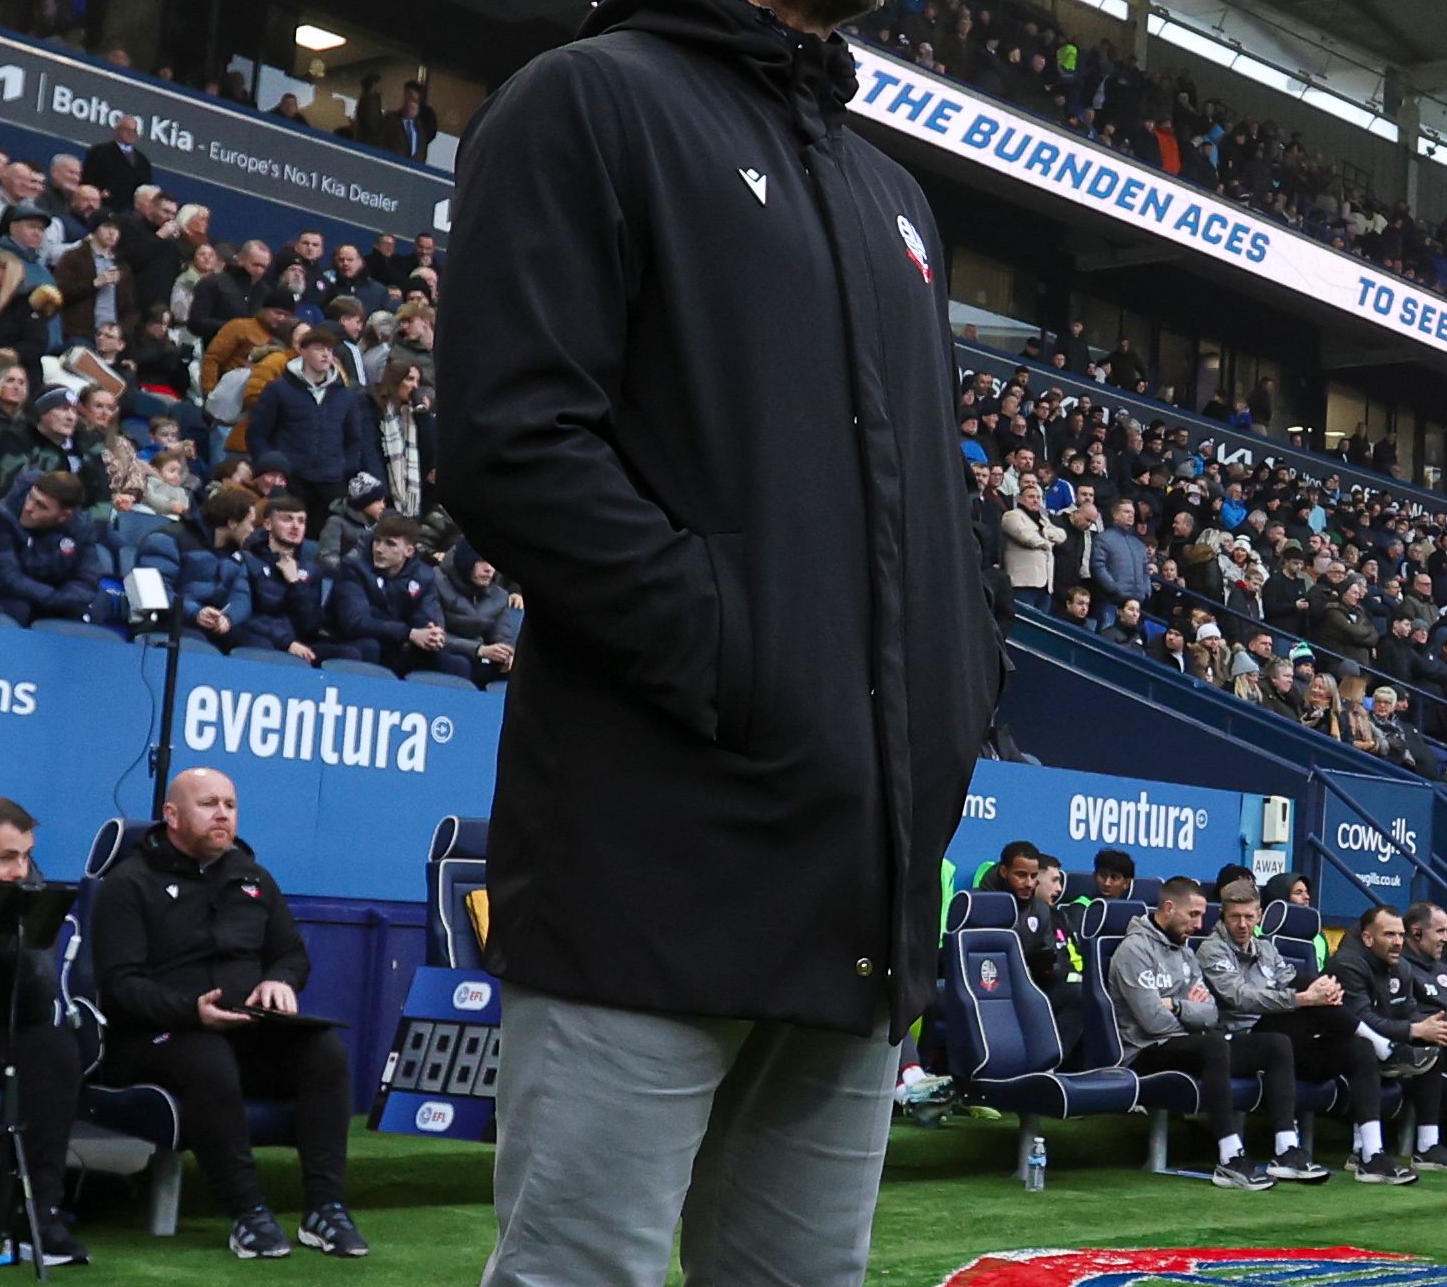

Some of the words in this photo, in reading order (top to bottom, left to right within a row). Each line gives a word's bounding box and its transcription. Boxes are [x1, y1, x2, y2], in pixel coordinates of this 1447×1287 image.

[150, 115, 194, 152] Kia
[209, 140, 280, 178] Europe's
[283, 163, 318, 190] No.1
[320, 174, 346, 198] Kia
[348, 183, 398, 214] Dealer
[862, 70, 963, 135] THE
[960, 114, 1175, 223] BURNDEN
[1174, 204, 1272, 264] ACES
[1357, 276, 1396, 316] TO
[183, 684, 430, 773] eventura
[1069, 791, 1195, 851] eventura
[1337, 817, 1417, 863] cowgills
[1255, 863, 1284, 874] AWAY
[469, 990, 484, 1003] EFL
[430, 1111, 447, 1124] EFL
